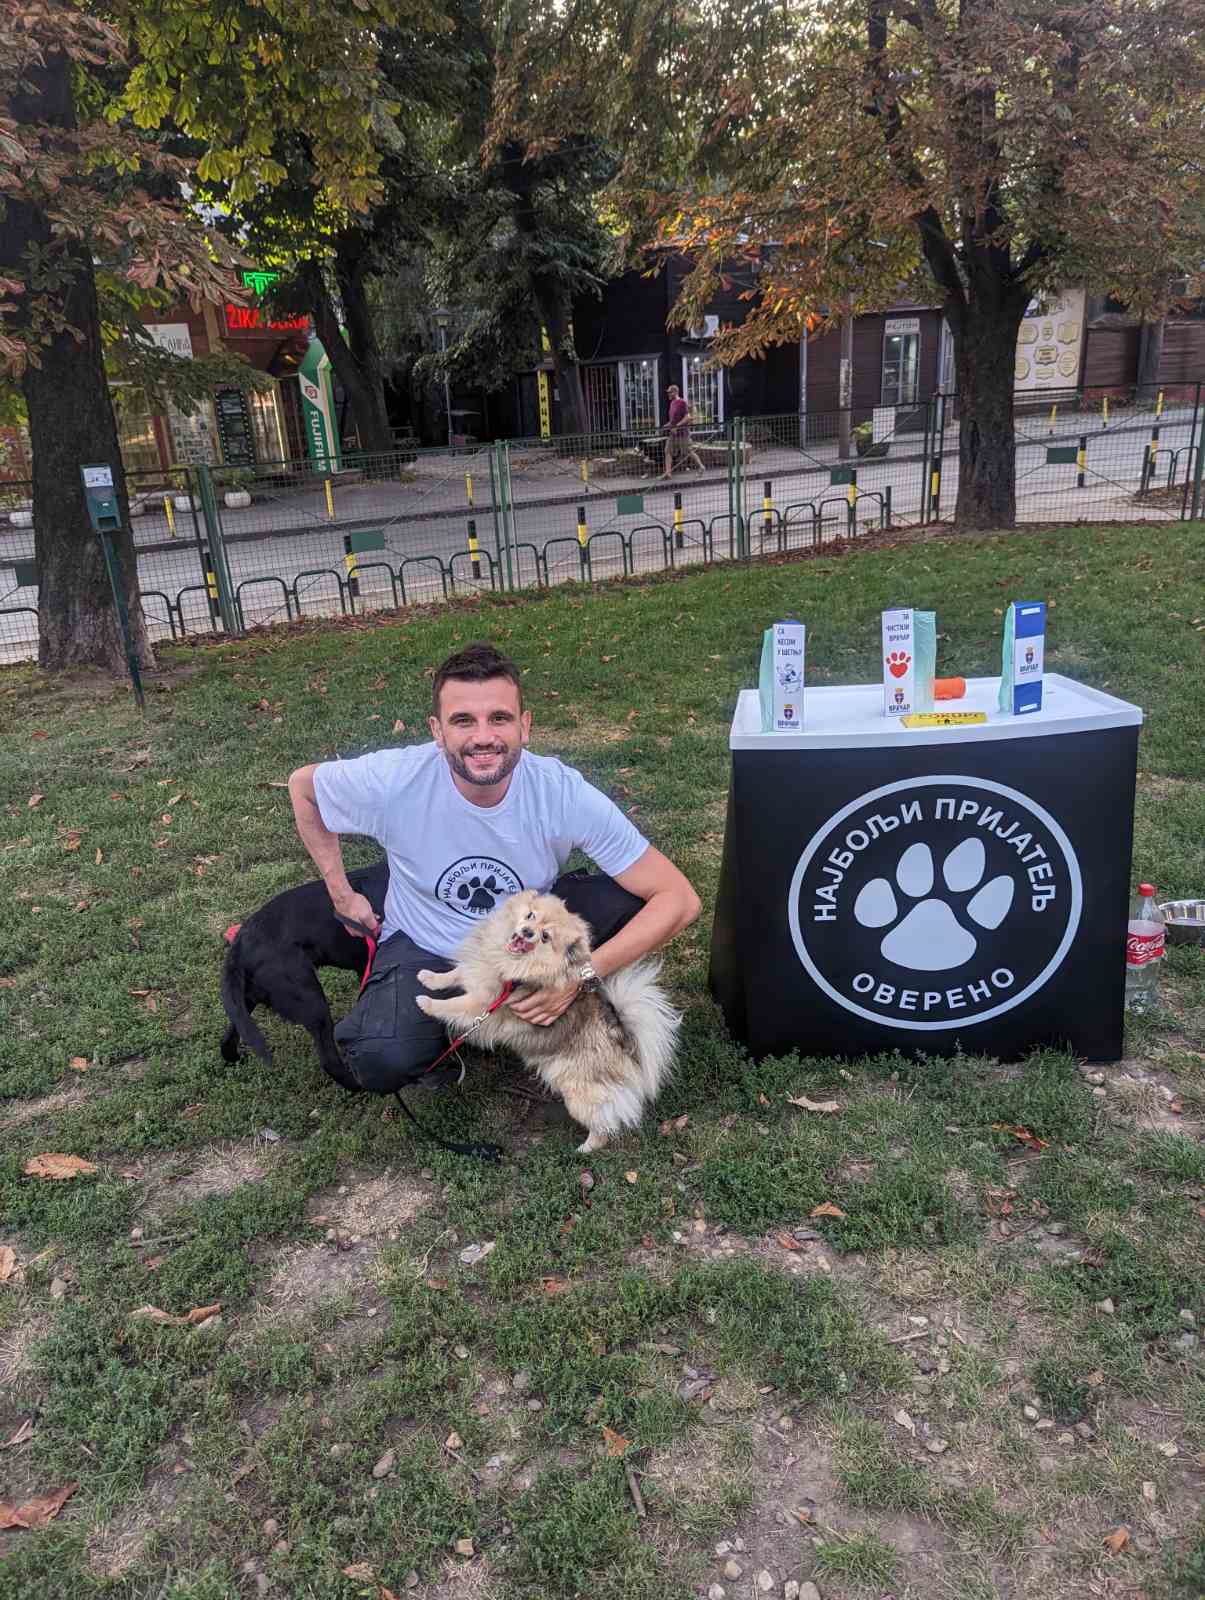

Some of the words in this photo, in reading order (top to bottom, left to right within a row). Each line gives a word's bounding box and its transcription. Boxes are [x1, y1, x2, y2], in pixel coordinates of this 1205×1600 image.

[310, 410, 327, 471] FUJIFILM
[443, 863, 477, 899] НАЈБОЉИ
[813, 800, 924, 922] НАЈБОЉИ
[934, 798, 1057, 913] ПРИЈАТЕЉ
[852, 967, 1015, 1011] ОВЕРЕНО
